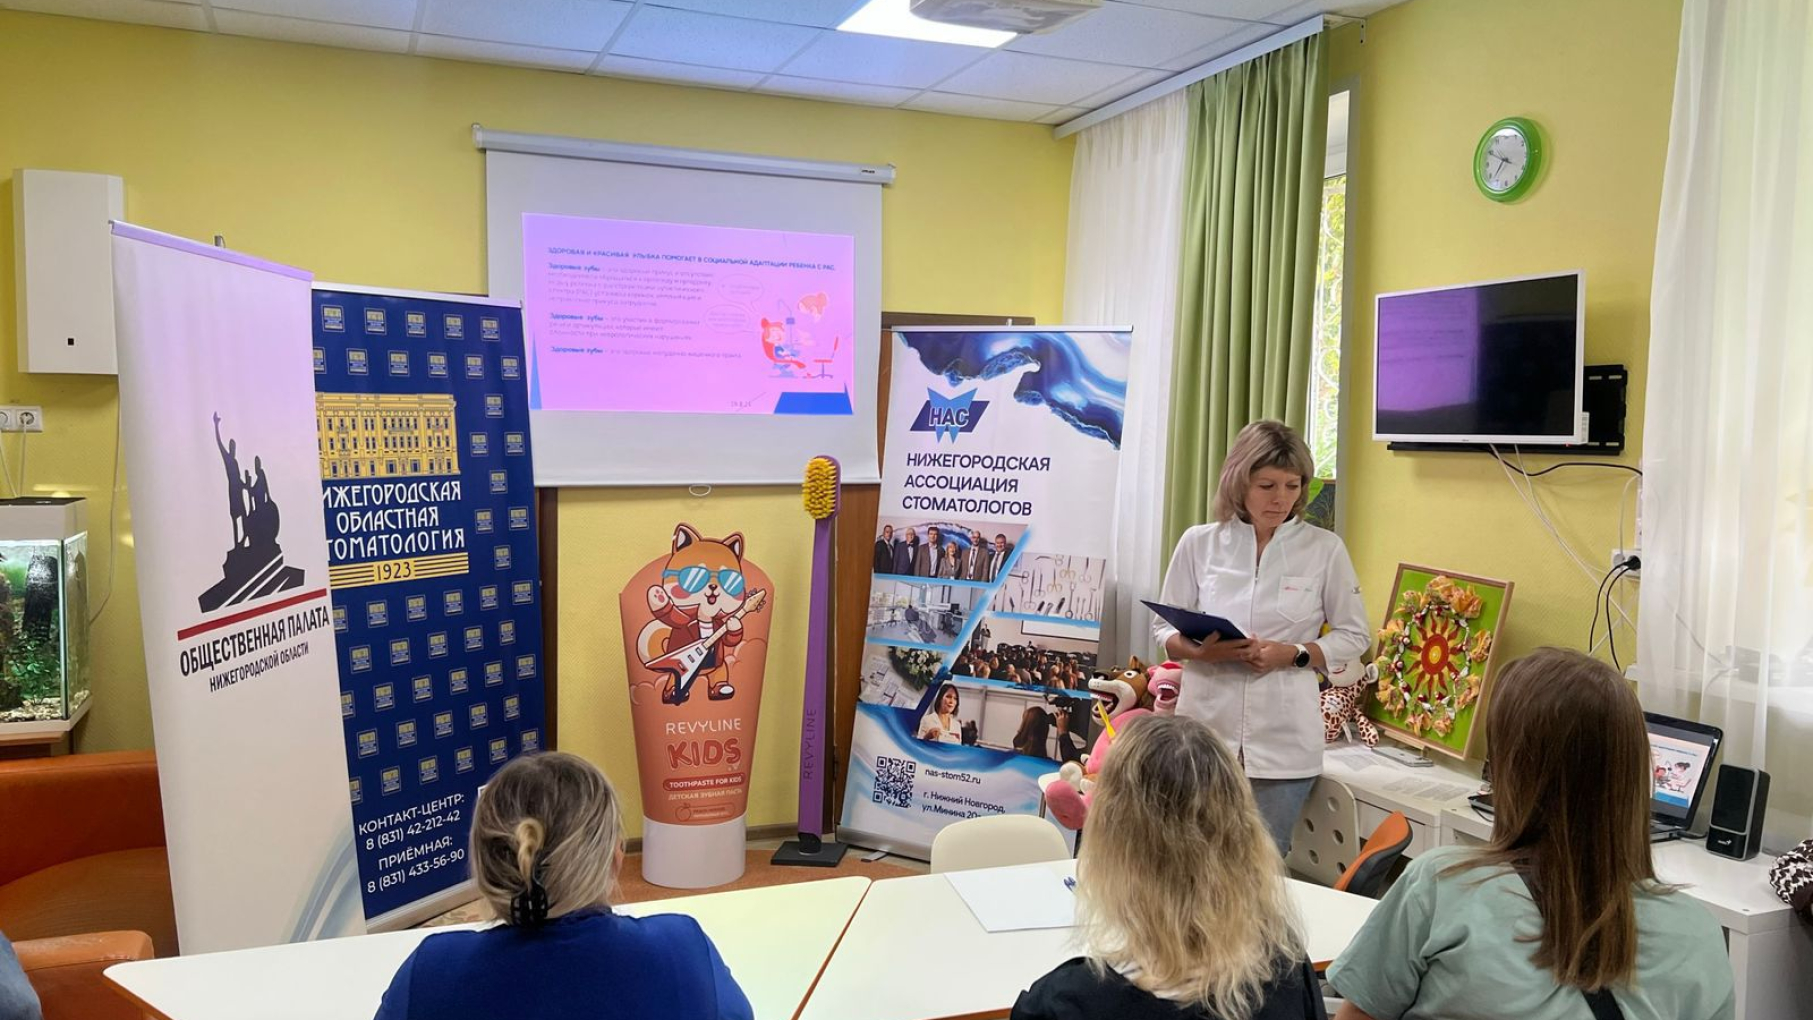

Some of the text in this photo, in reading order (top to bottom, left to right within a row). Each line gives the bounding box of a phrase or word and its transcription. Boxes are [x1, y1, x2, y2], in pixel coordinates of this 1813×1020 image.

[548, 247, 584, 256] ЗДОРОВАЯ
[593, 250, 629, 258] КРАСИВАЯ
[632, 252, 660, 260] УЛЫБКА
[662, 254, 696, 262] ПОМОГАЕТ
[704, 257, 748, 265] СОЦИАЛЬНОЙ
[750, 260, 787, 268] АДАПТАЦИИ
[549, 262, 581, 270] Здоровые
[550, 312, 583, 321] Здоровые
[587, 314, 604, 322] зубы
[550, 346, 584, 354] Здоровые
[587, 347, 603, 355] зубы
[929, 407, 970, 427] НАС
[906, 452, 1051, 472] НИЖЕГОРОДСКАЯ
[904, 474, 1018, 494] АССОЦИАЦИЯ
[323, 481, 461, 508] ИЖЕГОРОДСКАЯ
[902, 496, 1032, 516] СТОМАТОЛОГОВ
[336, 506, 439, 534] ОБЛАСТНАЯ
[326, 528, 465, 561] ТОМАТОЛОГИЯ
[377, 562, 412, 581] 1923
[180, 606, 330, 677] ОБЩЕСТВЕННАЯ ПАЛАТА
[210, 641, 309, 692] НИЖЕГОРОДСКОЙ ОБЛАСТИ
[666, 718, 741, 735] REVYLINE
[667, 738, 741, 769] KIDS
[803, 709, 816, 780] REVYLINE
[670, 779, 714, 789] TOOTHPASTE
[925, 768, 981, 784] nas-stom52.ru
[668, 793, 699, 801] ДЕТСКАЯ
[700, 790, 725, 799] ЗУБНАЯ
[923, 791, 1005, 814] г. Нижний Новгород,
[359, 793, 465, 836] КОНТАКТ-ЦЕНТР:
[967, 810, 981, 818] 20
[366, 810, 460, 850] 8 (831) 42-212-42
[378, 836, 453, 871] ПРИЁМНАЯ:
[367, 849, 464, 893] 8 (831) 433-56-90
